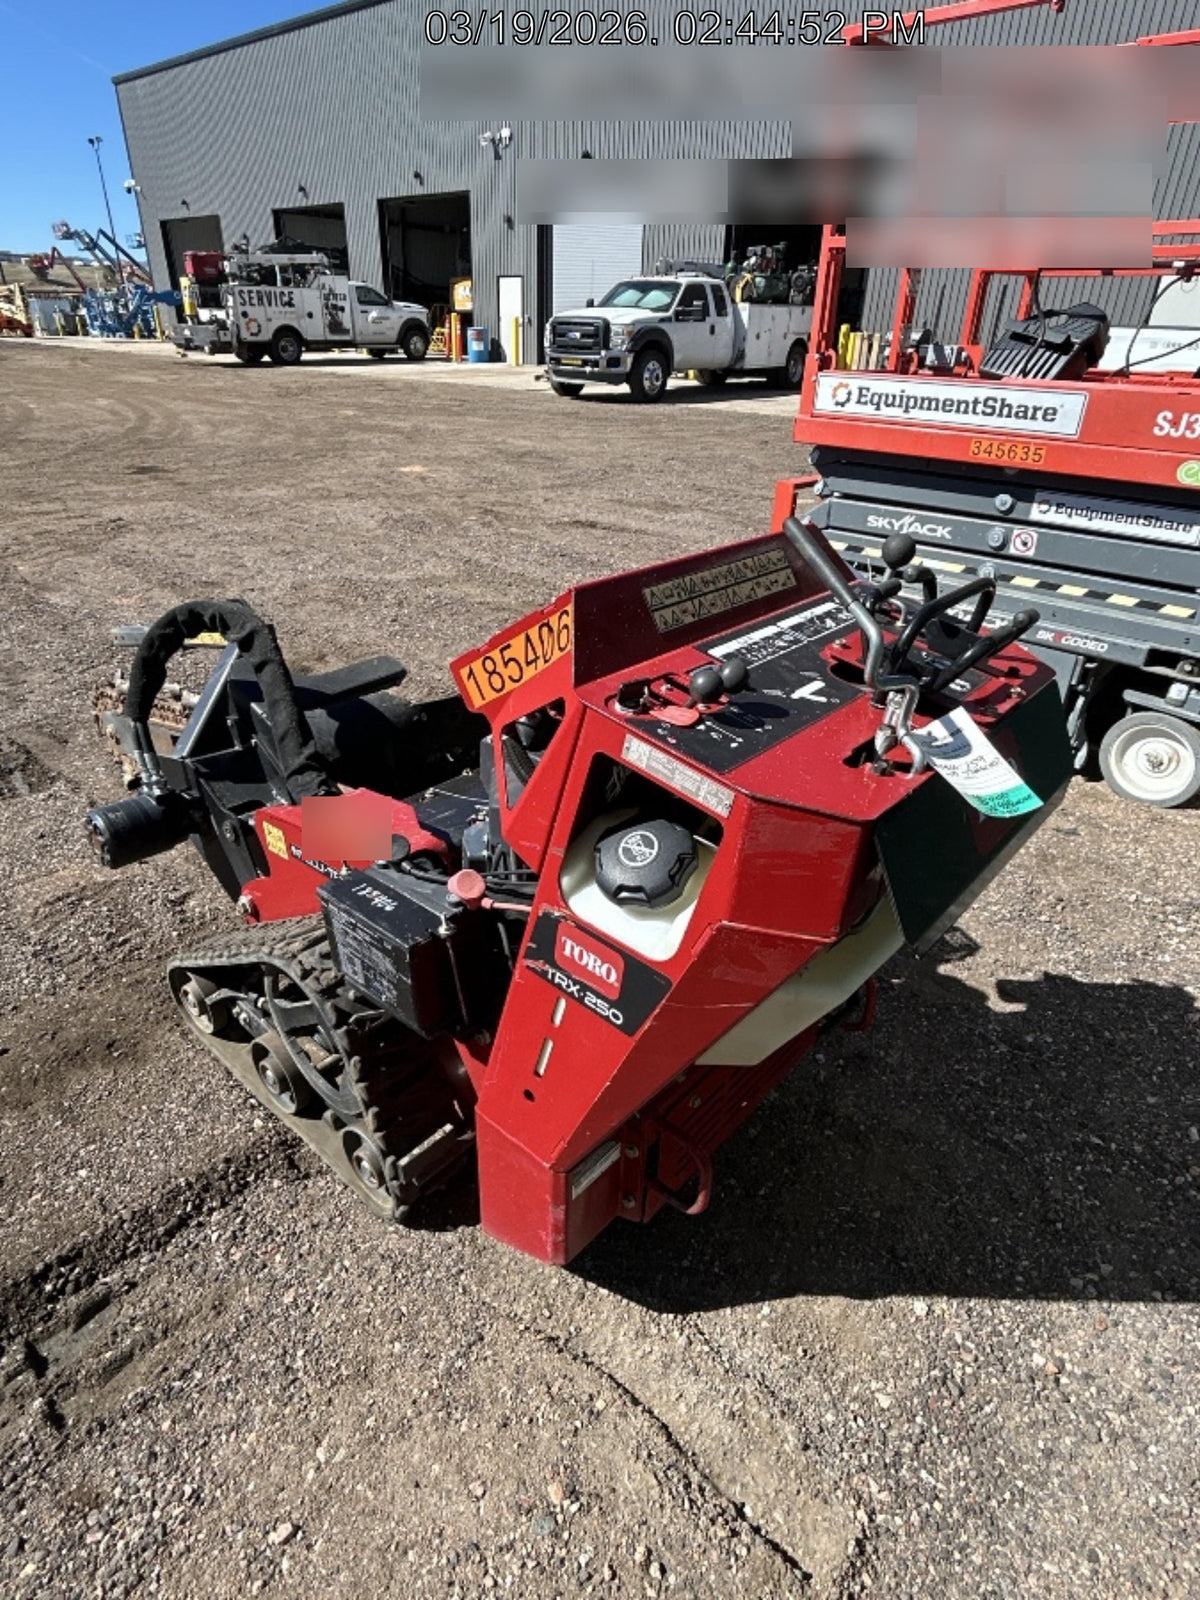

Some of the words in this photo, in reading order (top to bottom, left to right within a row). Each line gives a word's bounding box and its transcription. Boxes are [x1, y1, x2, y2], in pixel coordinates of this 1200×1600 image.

[237, 287, 297, 308] SERVICE
[855, 386, 1058, 422] EquipmentShare
[970, 440, 1044, 463] 345635
[866, 513, 952, 539] SKYJACK
[1055, 503, 1193, 533] EquipmentShare
[561, 936, 618, 984] TORO
